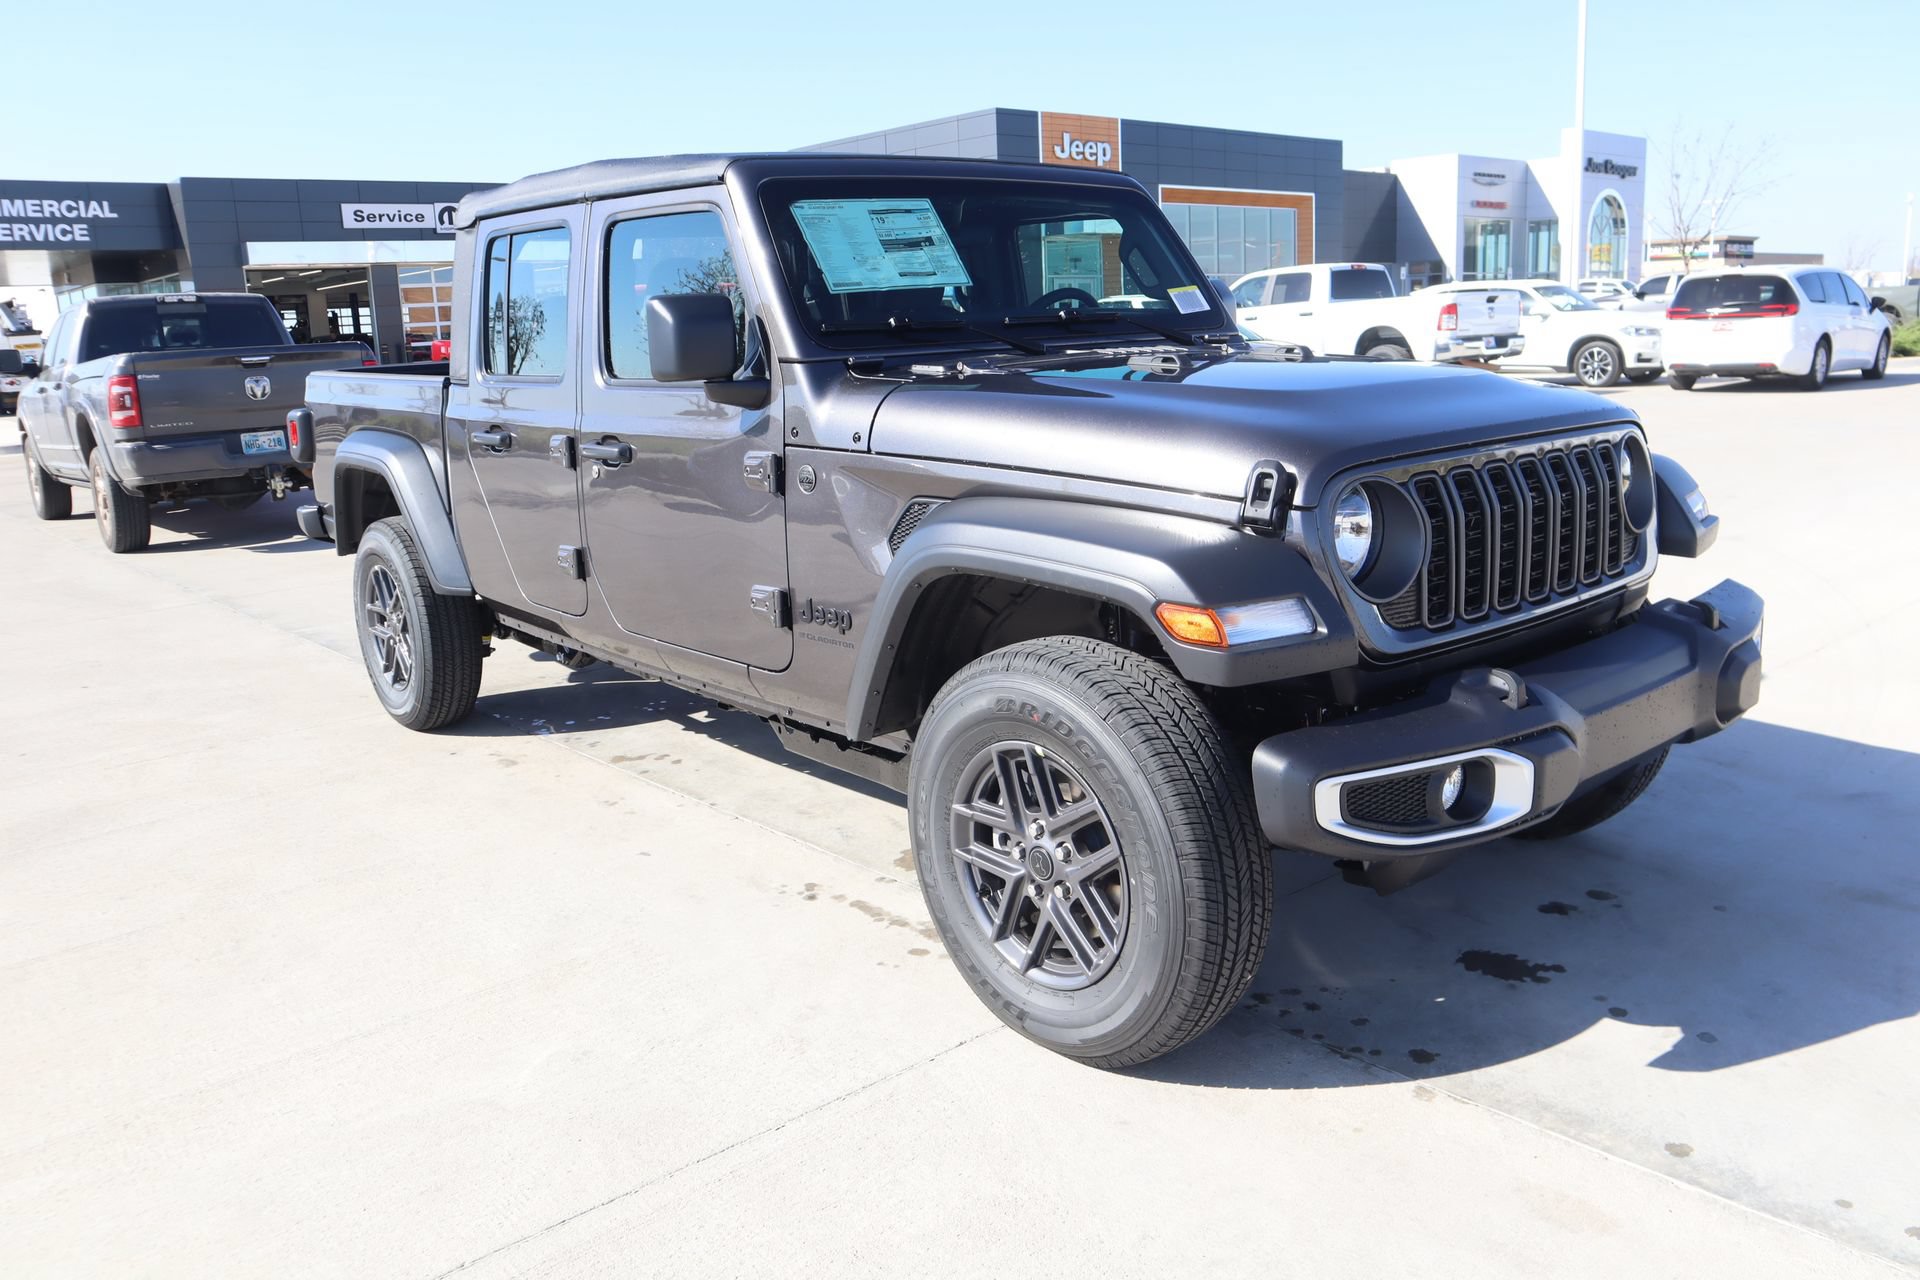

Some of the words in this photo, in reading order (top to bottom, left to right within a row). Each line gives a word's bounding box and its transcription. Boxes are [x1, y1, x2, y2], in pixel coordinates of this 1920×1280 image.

[1054, 132, 1112, 167] Jeep
[0, 199, 119, 218] MERCIAL
[353, 209, 425, 223] Service
[799, 598, 852, 635] Jeep
[806, 633, 855, 650] GLADIATOR
